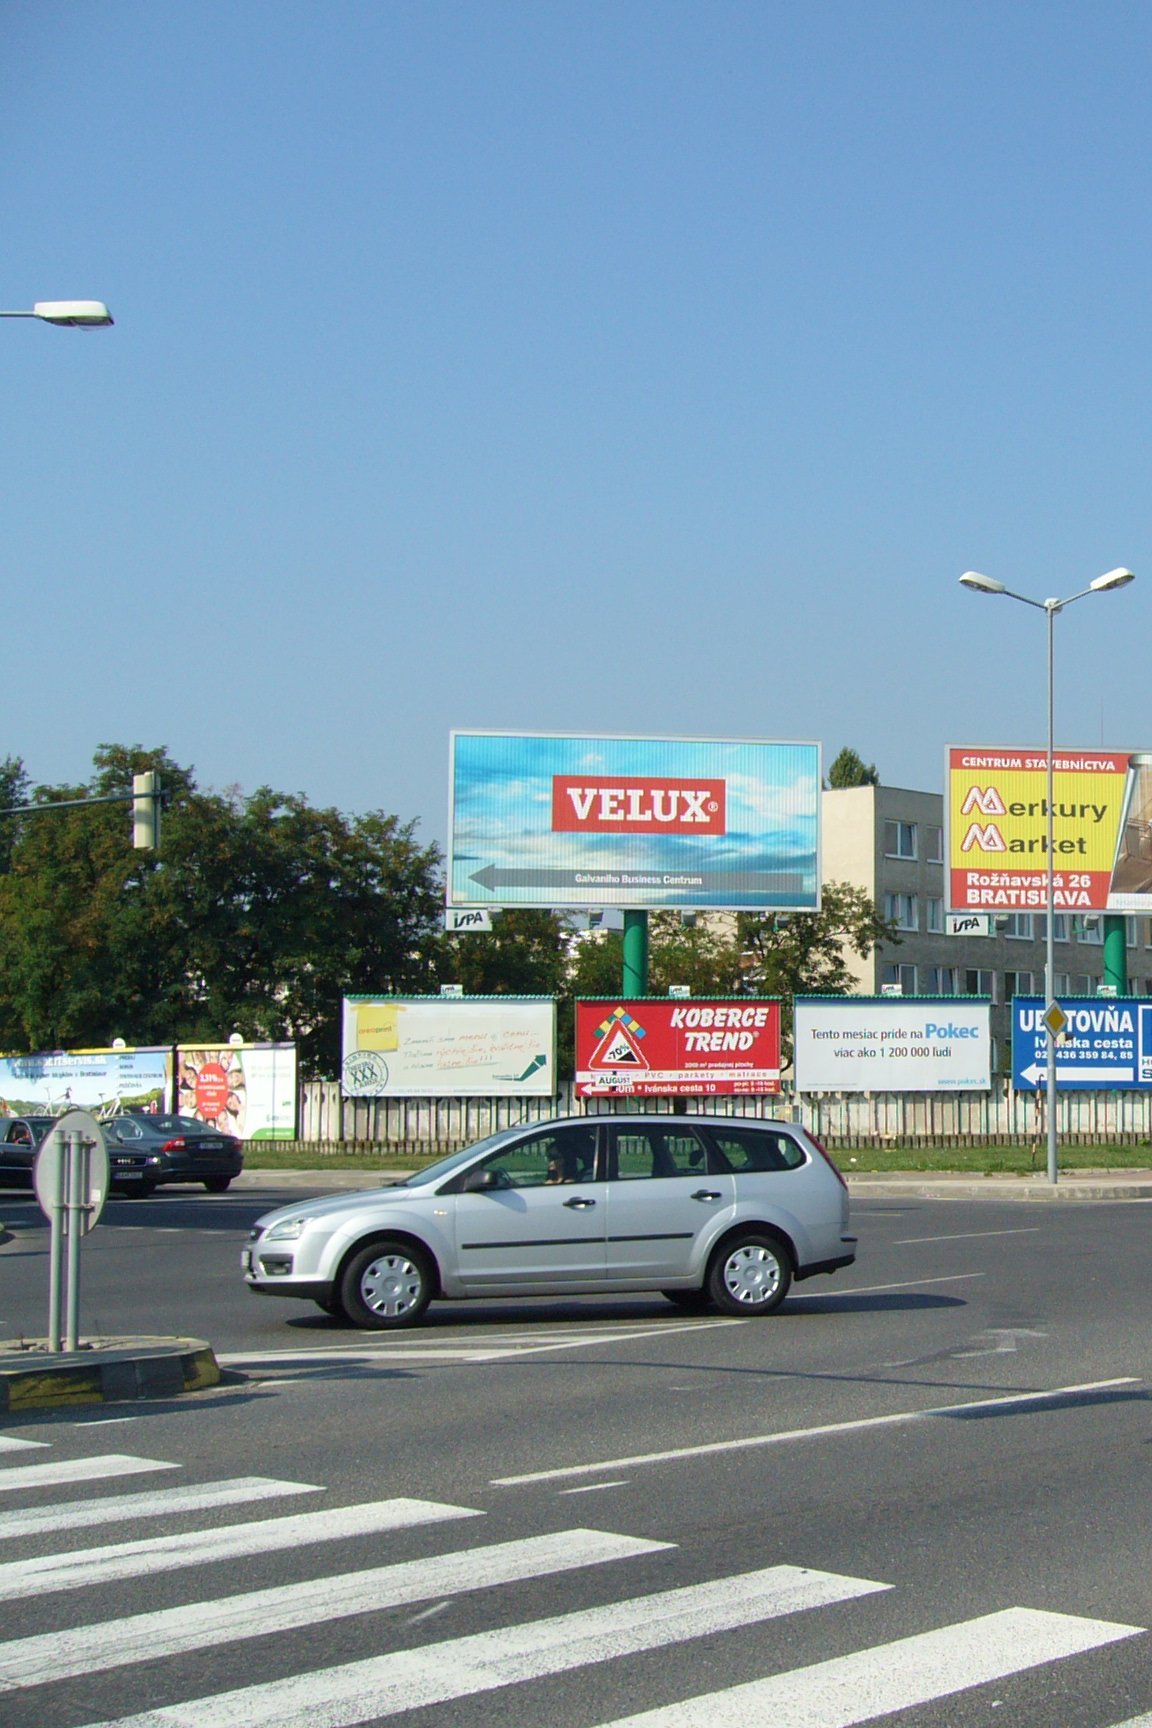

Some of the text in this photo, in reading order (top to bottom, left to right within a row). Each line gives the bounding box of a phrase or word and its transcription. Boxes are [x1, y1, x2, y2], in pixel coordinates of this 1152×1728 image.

[962, 757, 1022, 768] CENTRUM
[961, 785, 1107, 823] Merkury
[961, 822, 1087, 854] Market
[621, 874, 661, 884] Business
[663, 875, 702, 885] Centrum
[1068, 874, 1091, 887] 26
[967, 888, 1091, 905] BRATISLAVA
[670, 1008, 769, 1028] KOBERCE
[811, 1029, 840, 1039] Tento
[842, 1028, 878, 1039] mesiac
[910, 1030, 922, 1039] na
[925, 1023, 979, 1039] Pokec
[684, 1031, 753, 1051] TREND
[1094, 1037, 1133, 1048] cesta
[834, 1047, 853, 1057] viac
[857, 1047, 876, 1057] ako
[880, 1048, 885, 1057] 1
[889, 1048, 907, 1057] 200
[911, 1048, 930, 1057] 000
[1056, 1051, 1076, 1059] 436
[1079, 1051, 1098, 1059] 359
[350, 1064, 378, 1085] XXX
[599, 1076, 630, 1084] AUGUST
[678, 1071, 715, 1079] parkety
[706, 1083, 716, 1092] 10
